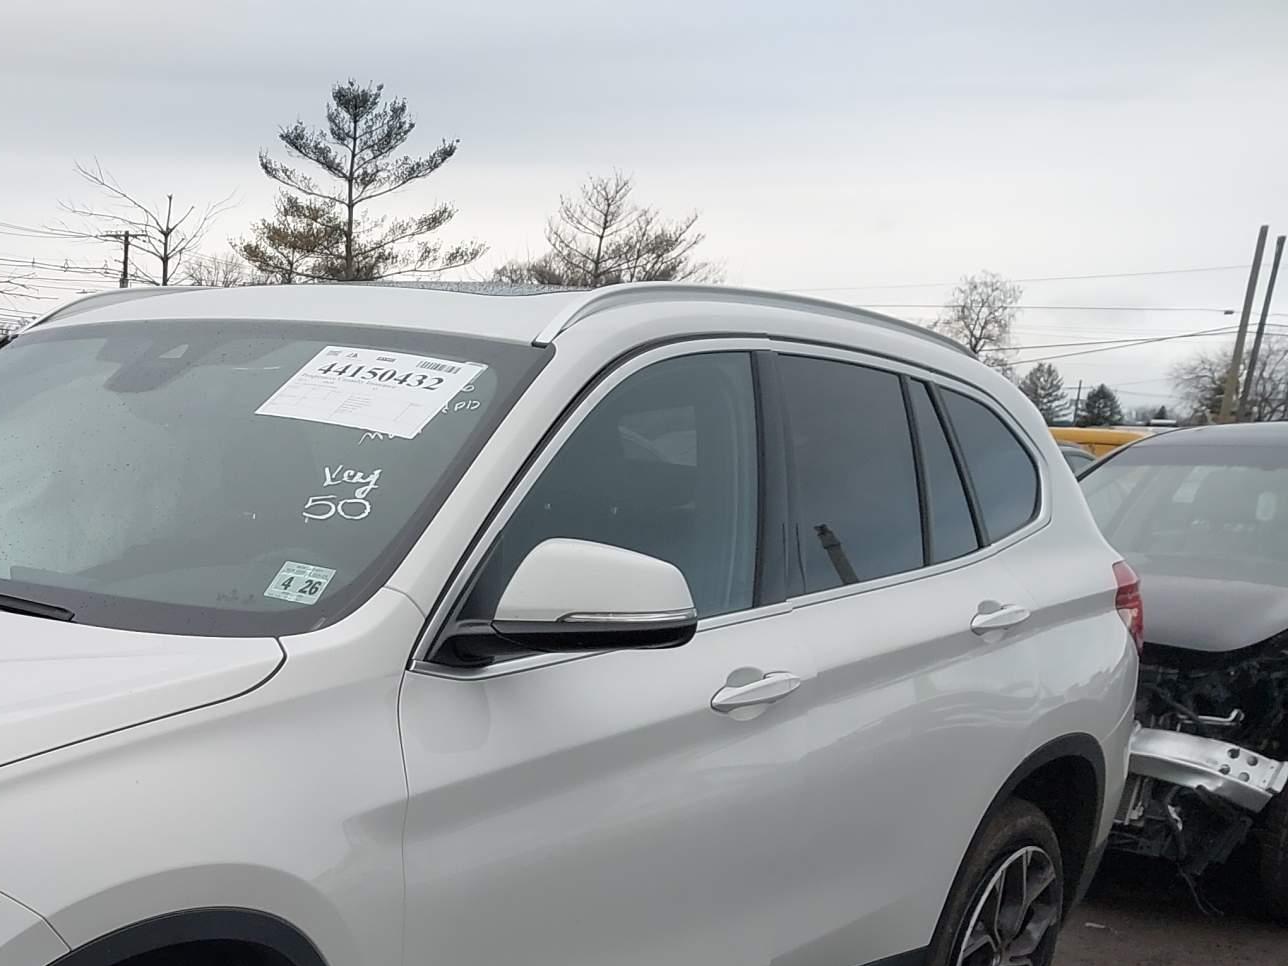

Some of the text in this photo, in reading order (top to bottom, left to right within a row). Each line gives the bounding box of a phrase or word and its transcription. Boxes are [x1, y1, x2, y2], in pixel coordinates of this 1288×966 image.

[318, 362, 445, 391] 44150432
[302, 495, 371, 521] 50
[281, 576, 295, 590] 4
[297, 579, 322, 596] 26
